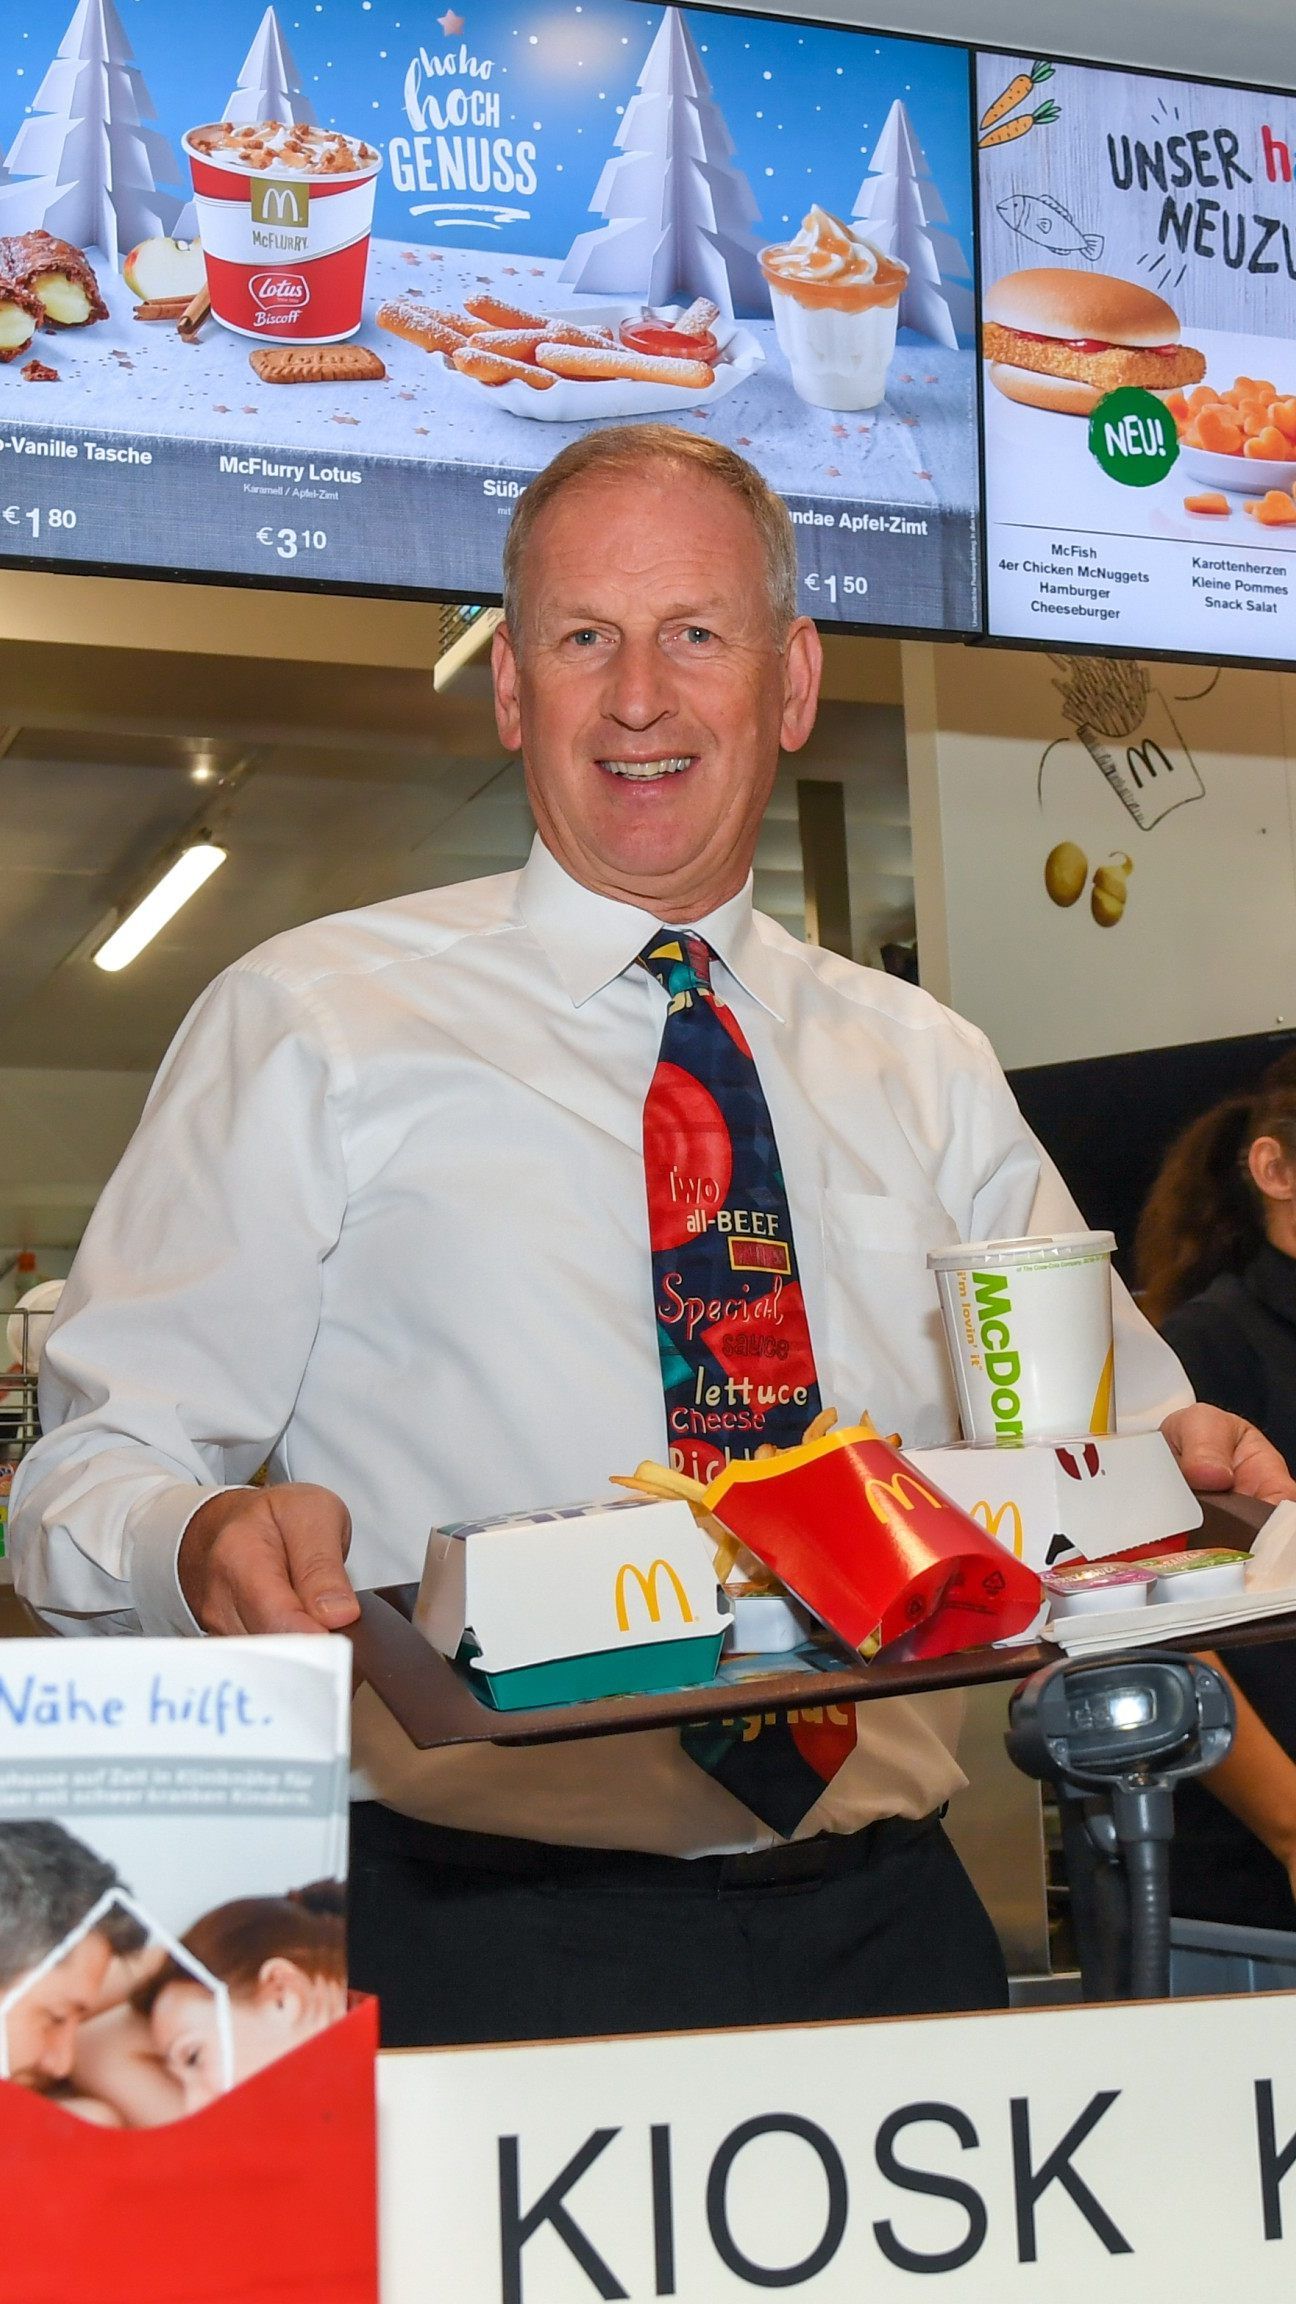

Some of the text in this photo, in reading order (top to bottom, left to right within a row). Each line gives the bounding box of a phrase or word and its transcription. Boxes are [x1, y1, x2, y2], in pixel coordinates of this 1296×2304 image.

[419, 43, 495, 80] hoho
[389, 136, 537, 194] GENUSS
[1107, 125, 1296, 193] UNSER h
[259, 278, 302, 298] Lotus
[253, 309, 302, 327] Biscoff
[1104, 415, 1166, 457] NEU!
[84, 442, 152, 465] Tasche
[219, 456, 362, 484] McFlurry Lotus
[243, 484, 283, 495] Karamell
[292, 488, 339, 500] Apfel-Zimt
[789, 510, 928, 535] ndae Apfel-Zimt
[1051, 543, 1097, 559] McFish
[999, 559, 1149, 584] 4er Chicken McNuggets
[1192, 557, 1287, 576] Karottenherzen
[1040, 582, 1110, 600] Hamburger
[1192, 576, 1288, 595] Kleine Pommes
[1031, 600, 1120, 620] Cheeseburger
[1205, 596, 1278, 613] Snack Salat
[686, 1209, 779, 1237] all-BEEF
[956, 1271, 967, 1298] i'm
[658, 1272, 784, 1341] Special
[961, 1303, 978, 1348] lovin'
[721, 1333, 790, 1360] sauce
[695, 1365, 808, 1406] lettuce
[0, 1674, 272, 1735] Nähe hilft.
[497, 2089, 1135, 2304] KIOSK
